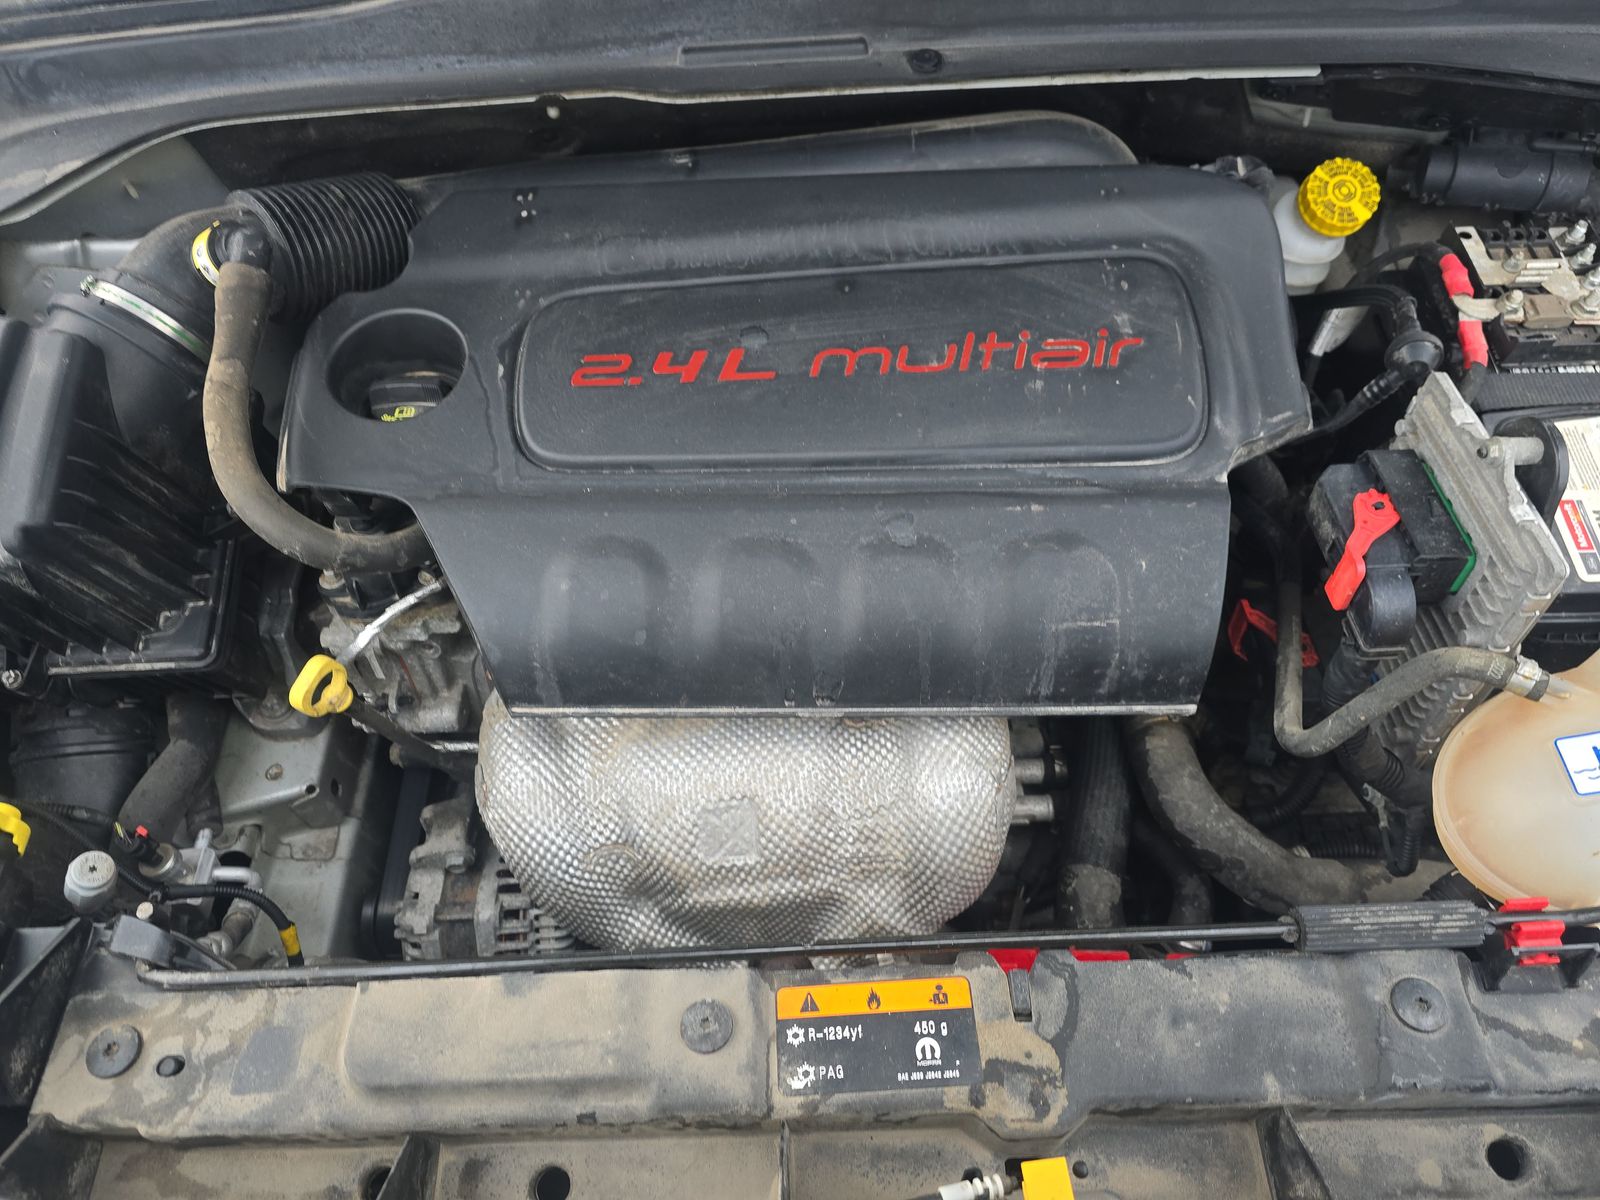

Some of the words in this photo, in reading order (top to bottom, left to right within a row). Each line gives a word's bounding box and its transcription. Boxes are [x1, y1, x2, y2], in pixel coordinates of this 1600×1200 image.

[809, 328, 1144, 378] multiair
[940, 1021, 948, 1036] g
[819, 1064, 844, 1080] PAG
